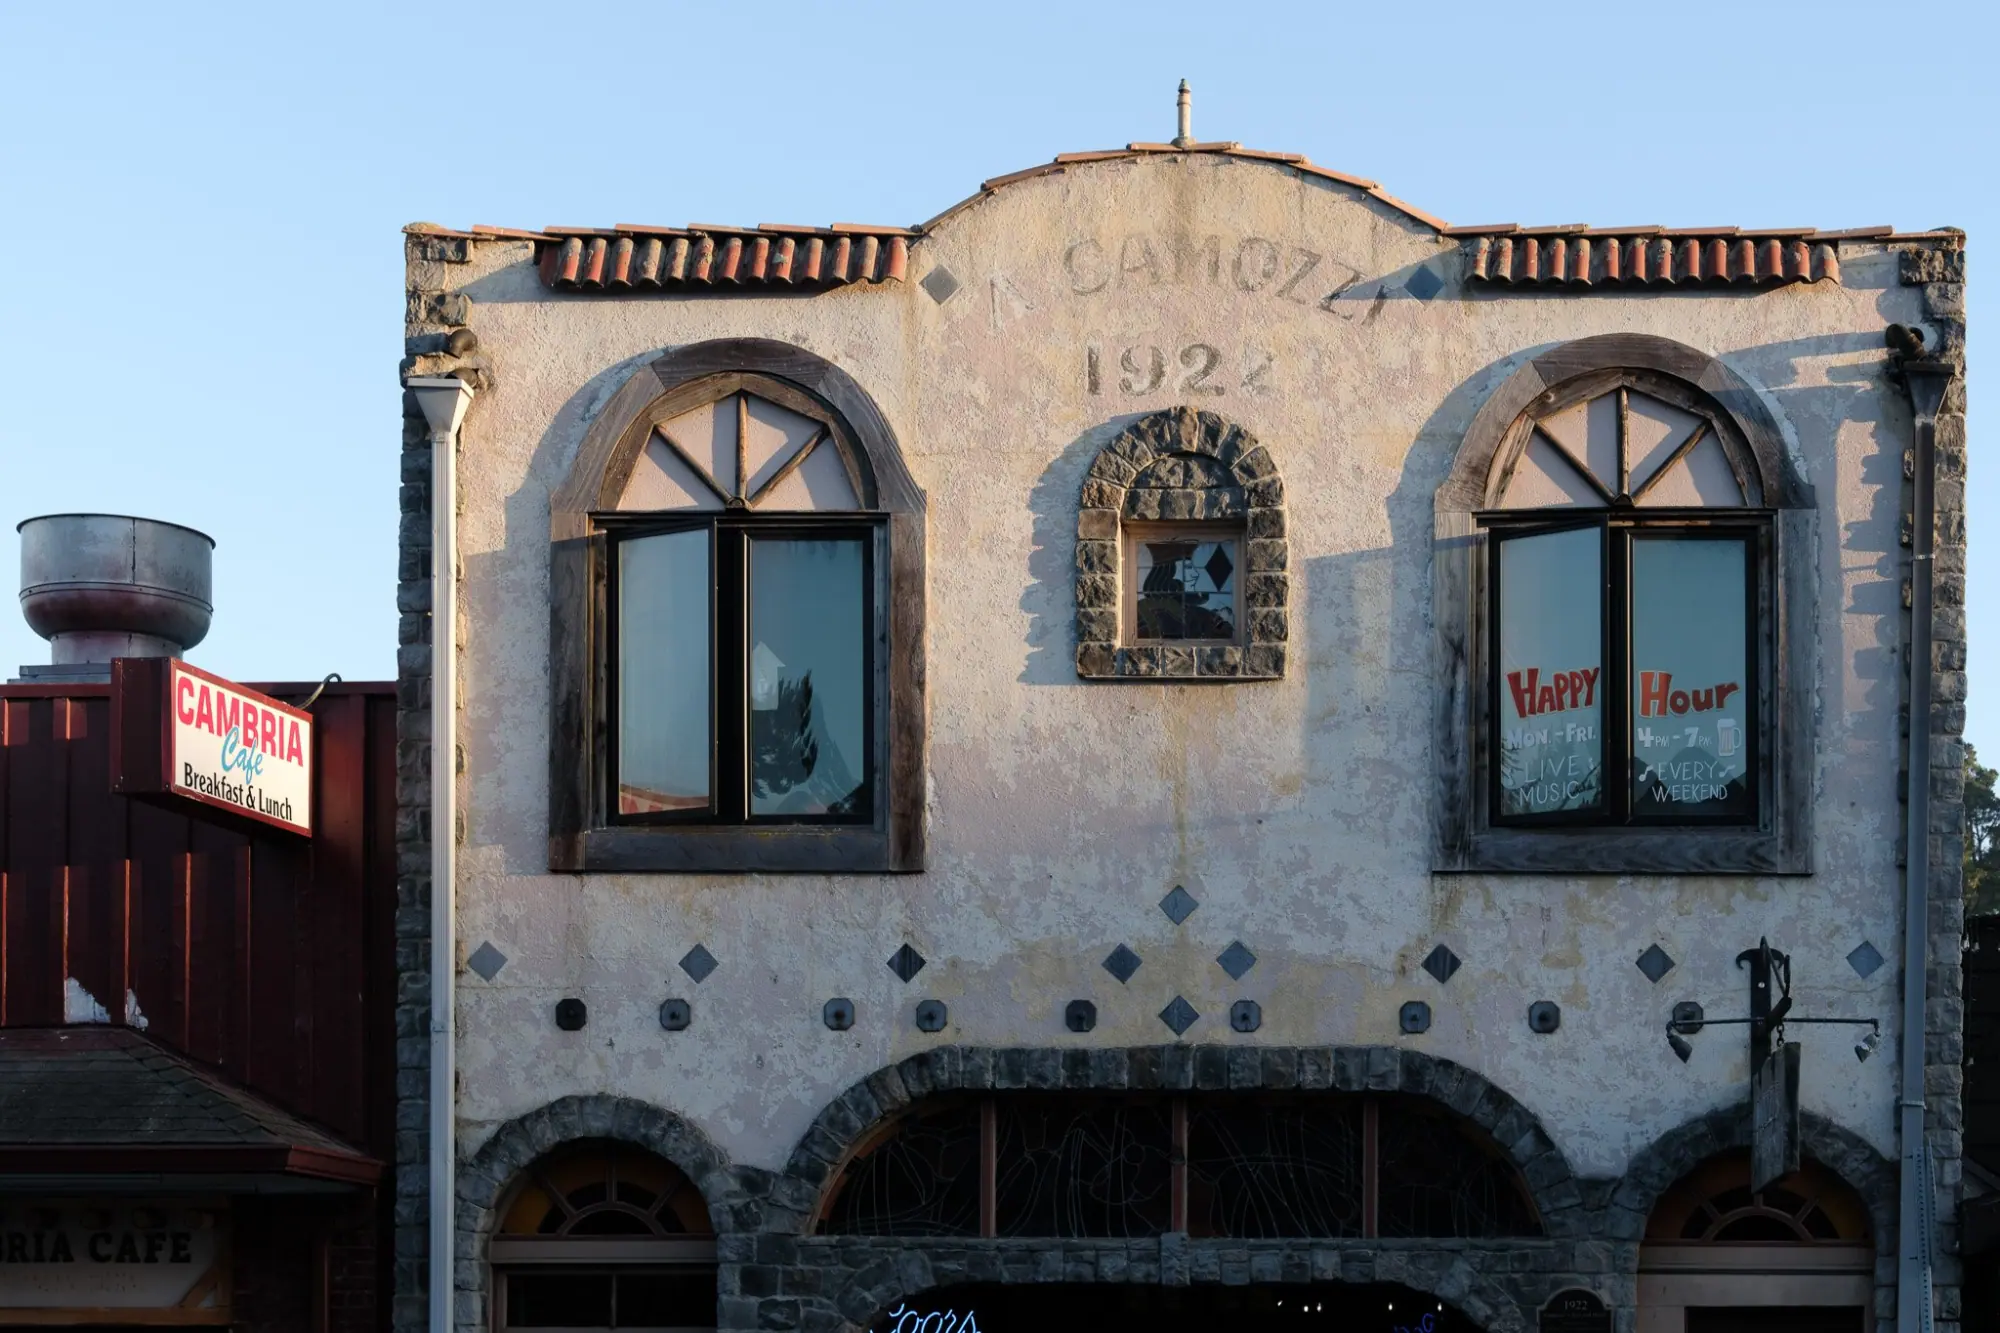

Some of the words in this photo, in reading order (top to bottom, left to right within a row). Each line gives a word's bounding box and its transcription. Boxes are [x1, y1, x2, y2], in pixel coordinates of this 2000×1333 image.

[177, 676, 303, 767] CAMBRIA
[221, 726, 264, 785] Cafe
[1524, 755, 1581, 783] LIVE
[1658, 761, 1717, 782] EVERY
[184, 761, 244, 806] Breakfast
[246, 785, 256, 809] &
[258, 788, 293, 821] Lunch
[1519, 780, 1580, 806] MUSIC
[1652, 783, 1728, 803] WEEKEND
[89, 1231, 192, 1263] CAFE
